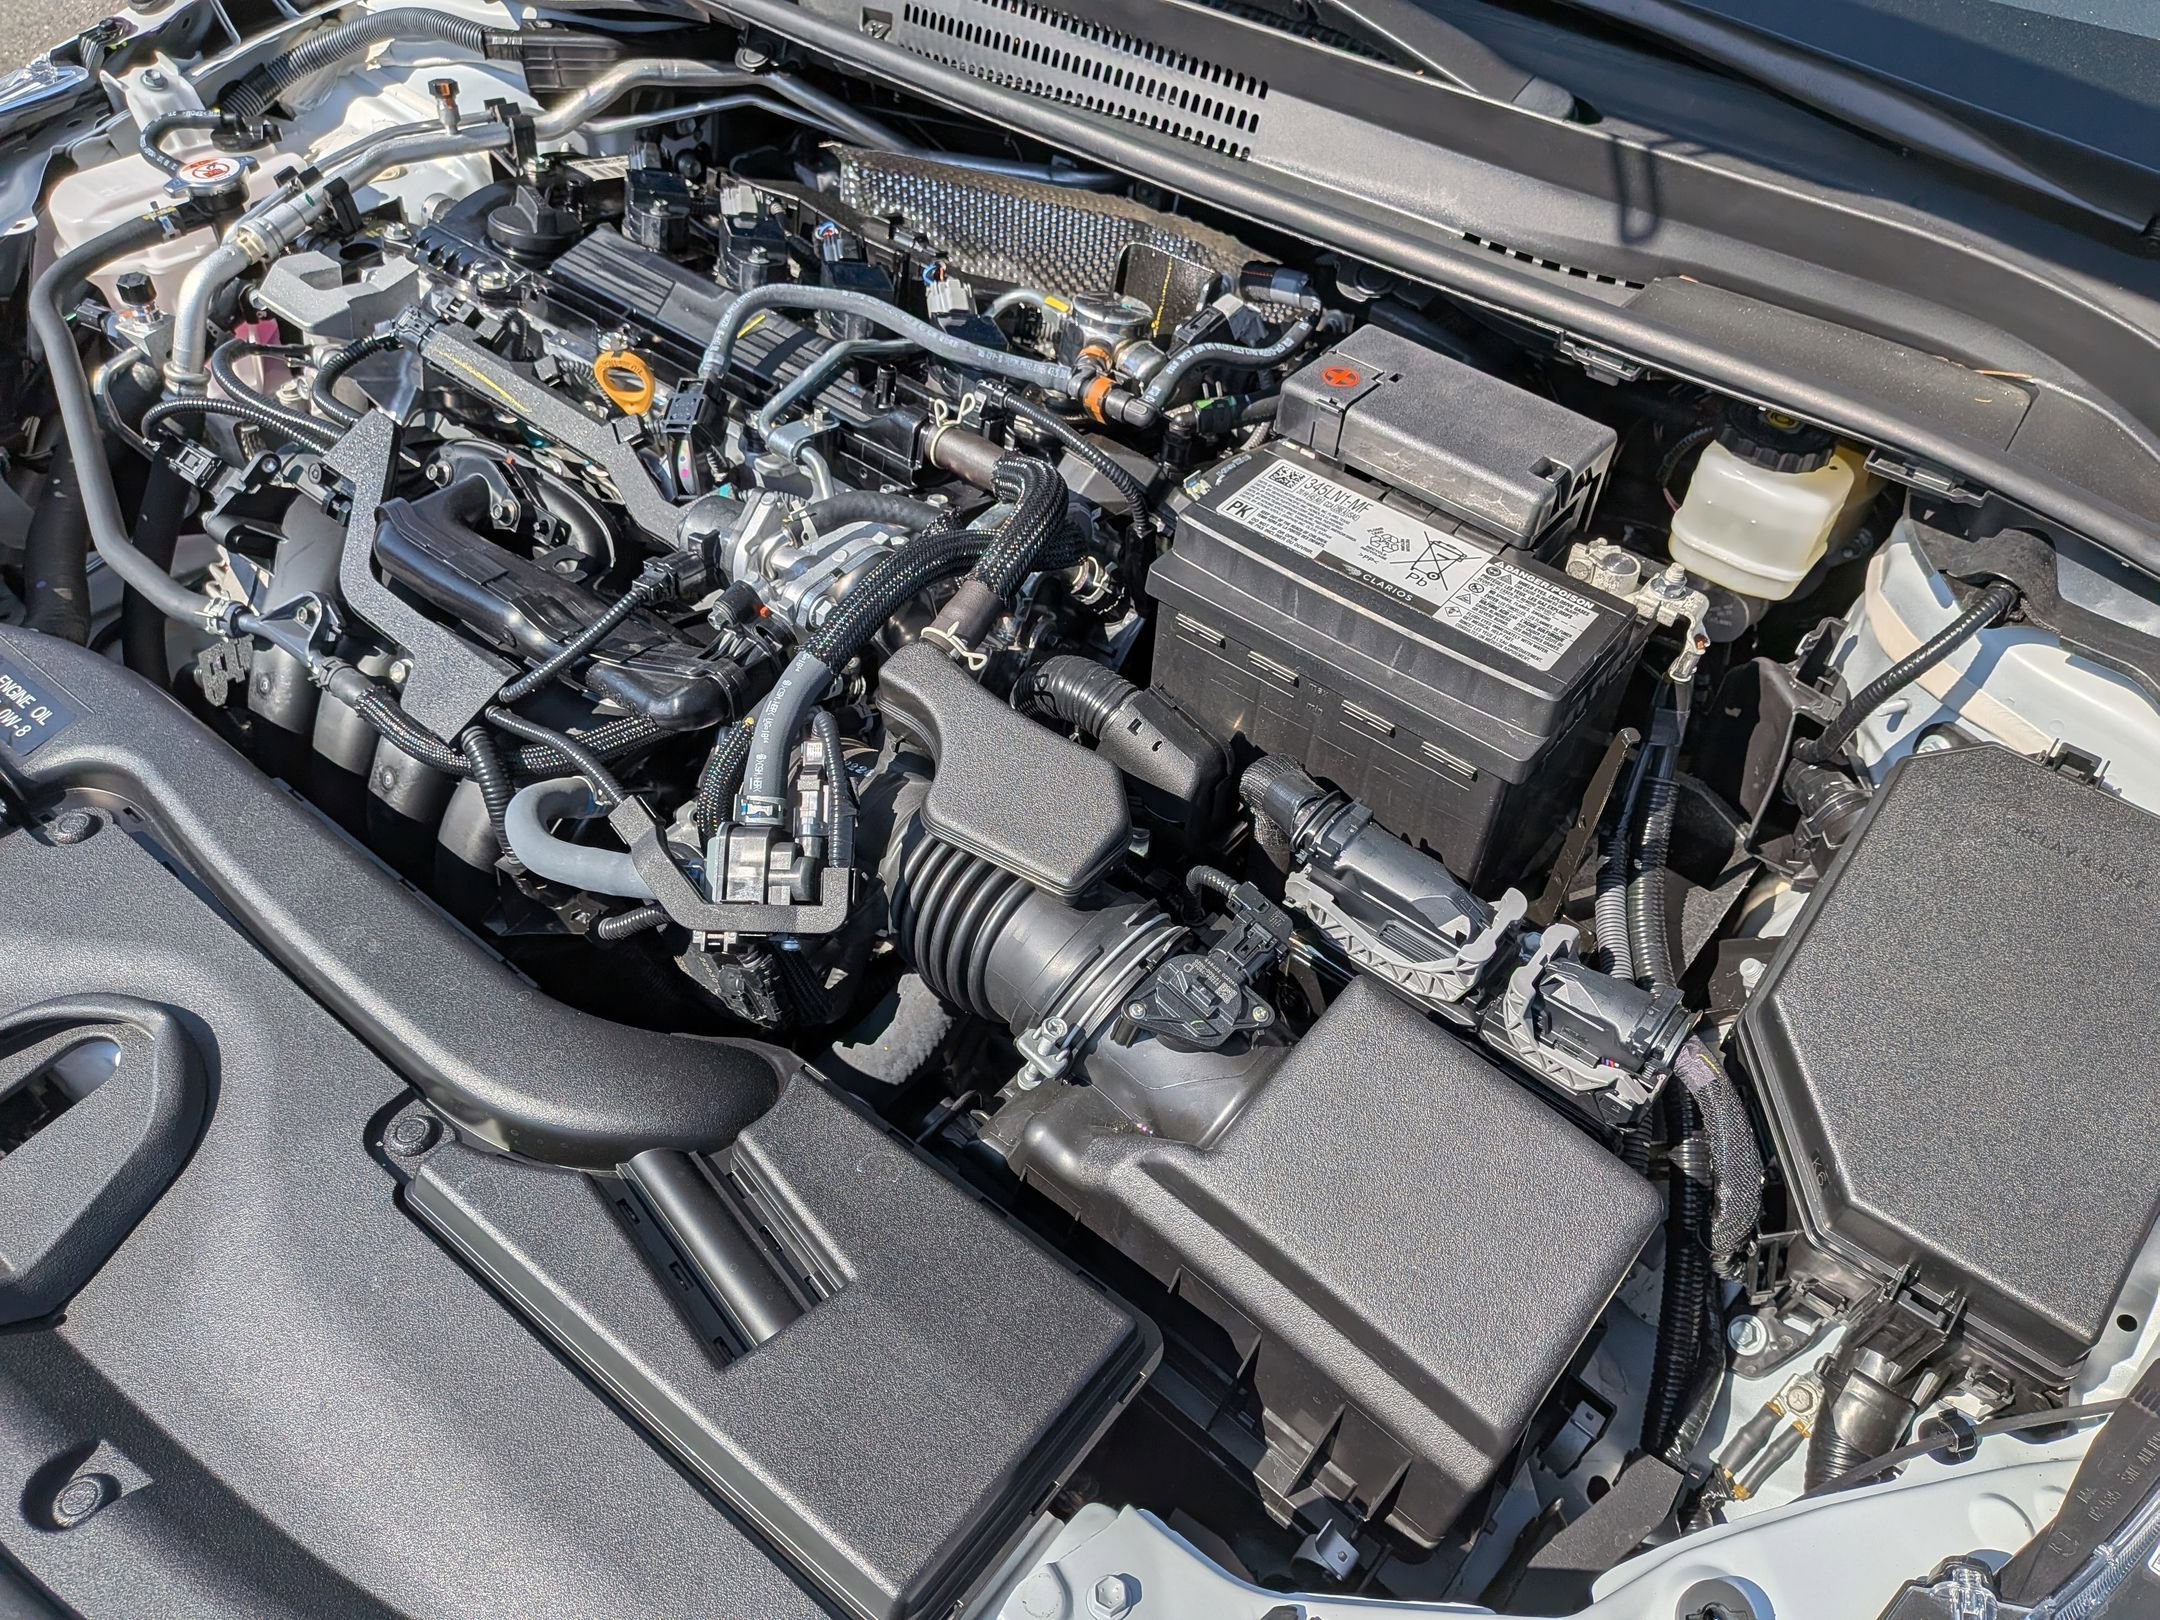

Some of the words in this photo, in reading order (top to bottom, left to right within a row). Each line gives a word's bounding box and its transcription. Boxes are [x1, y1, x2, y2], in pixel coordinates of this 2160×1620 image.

[1225, 499, 1254, 518] PK
[1304, 478, 1374, 513] 345LN1-MF
[1362, 574, 1414, 601] CLARIOS
[1405, 572, 1428, 586] Pb
[1503, 564, 1595, 609] DANGER/POISON
[0, 674, 37, 709] ENGINE
[30, 706, 53, 726] OIL
[0, 708, 32, 737] 0W-8
